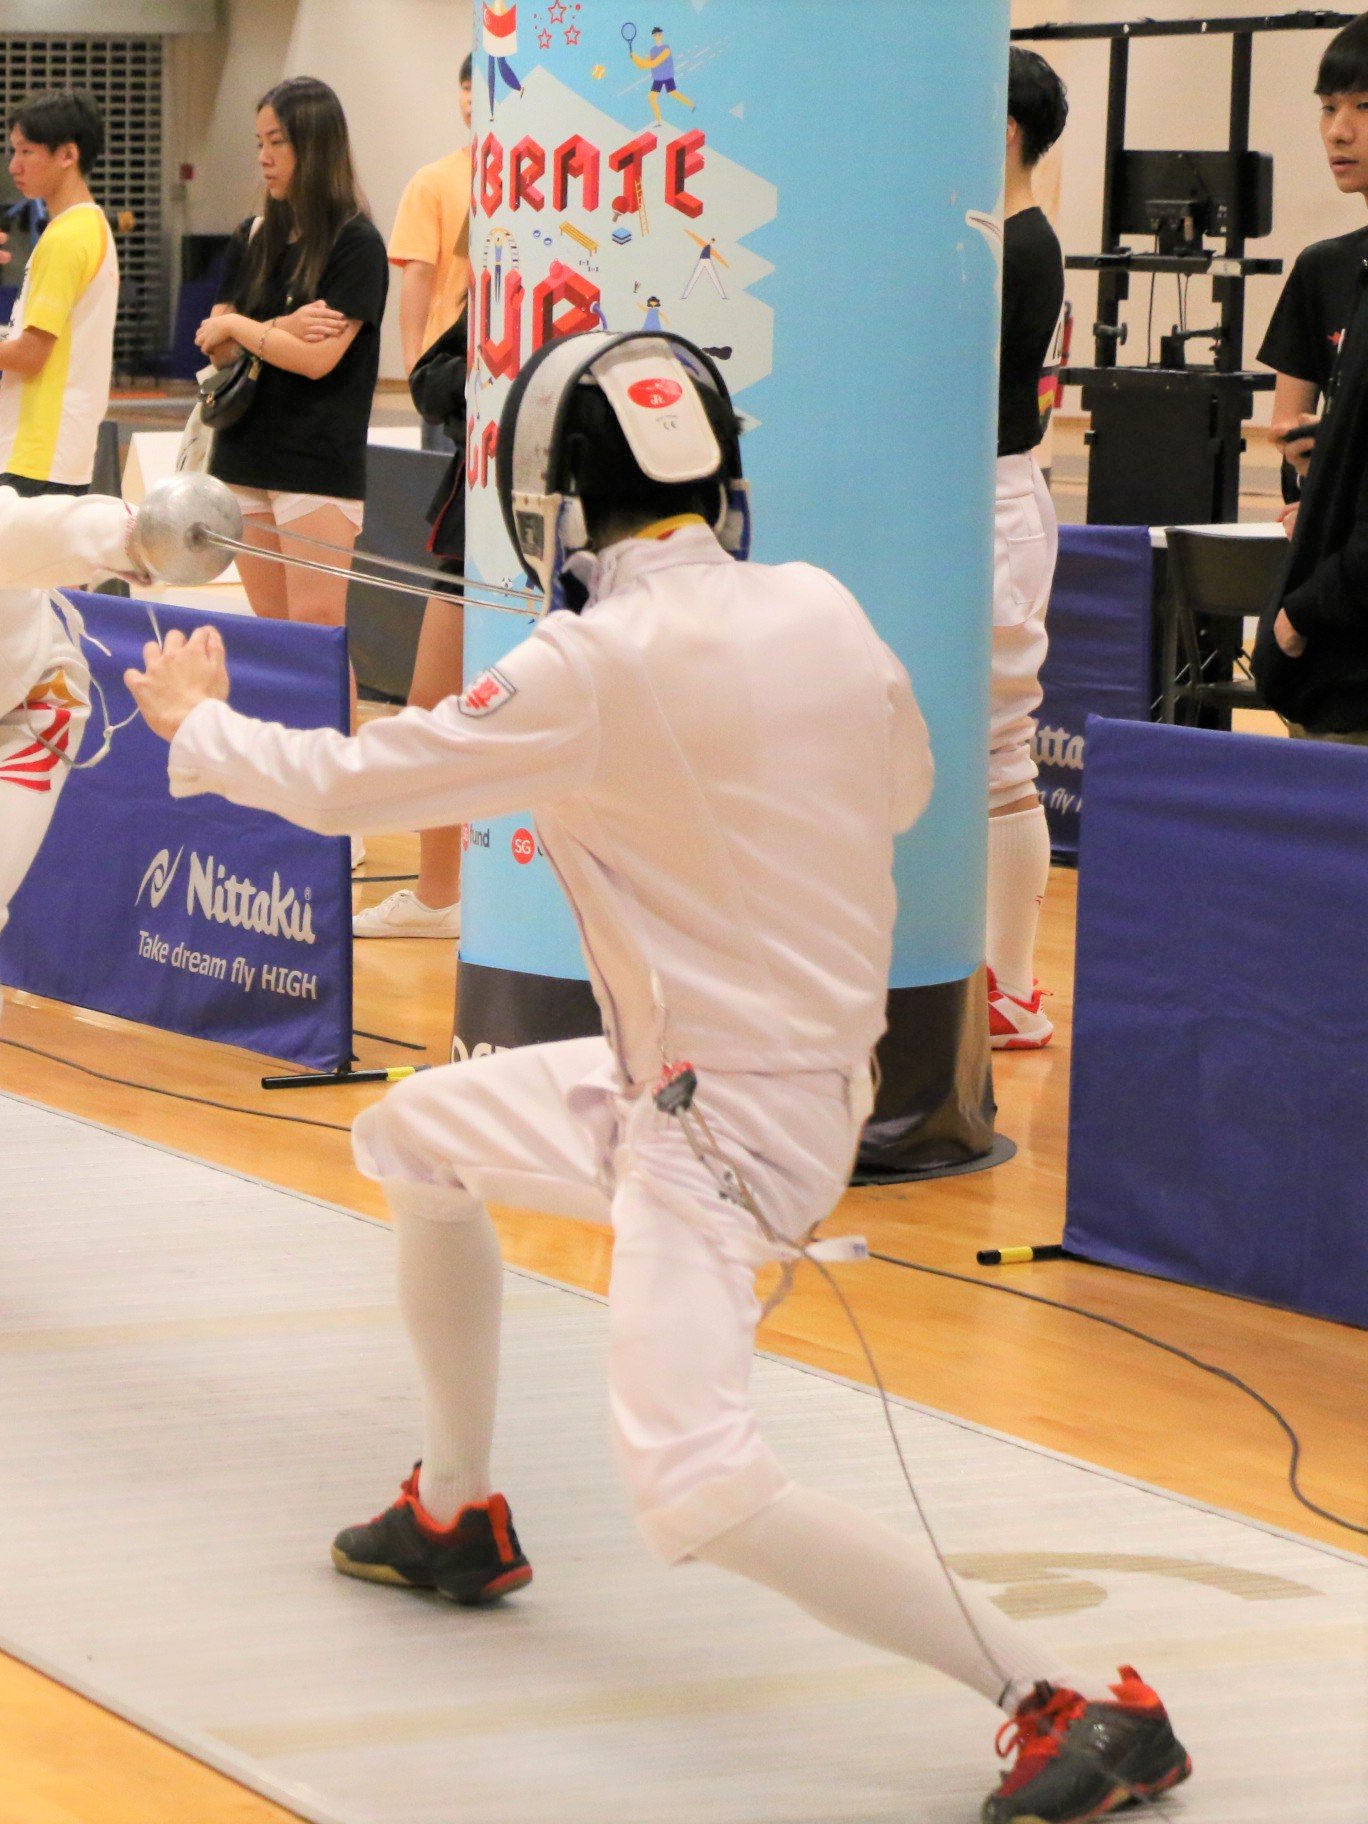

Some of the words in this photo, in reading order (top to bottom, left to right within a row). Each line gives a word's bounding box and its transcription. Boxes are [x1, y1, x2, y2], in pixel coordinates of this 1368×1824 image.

[471, 129, 706, 219] BRATE
[514, 838, 531, 855] SG
[138, 930, 170, 964] Take
[170, 941, 227, 980] dream
[231, 956, 256, 992] fly
[261, 964, 318, 1000] HIGH
